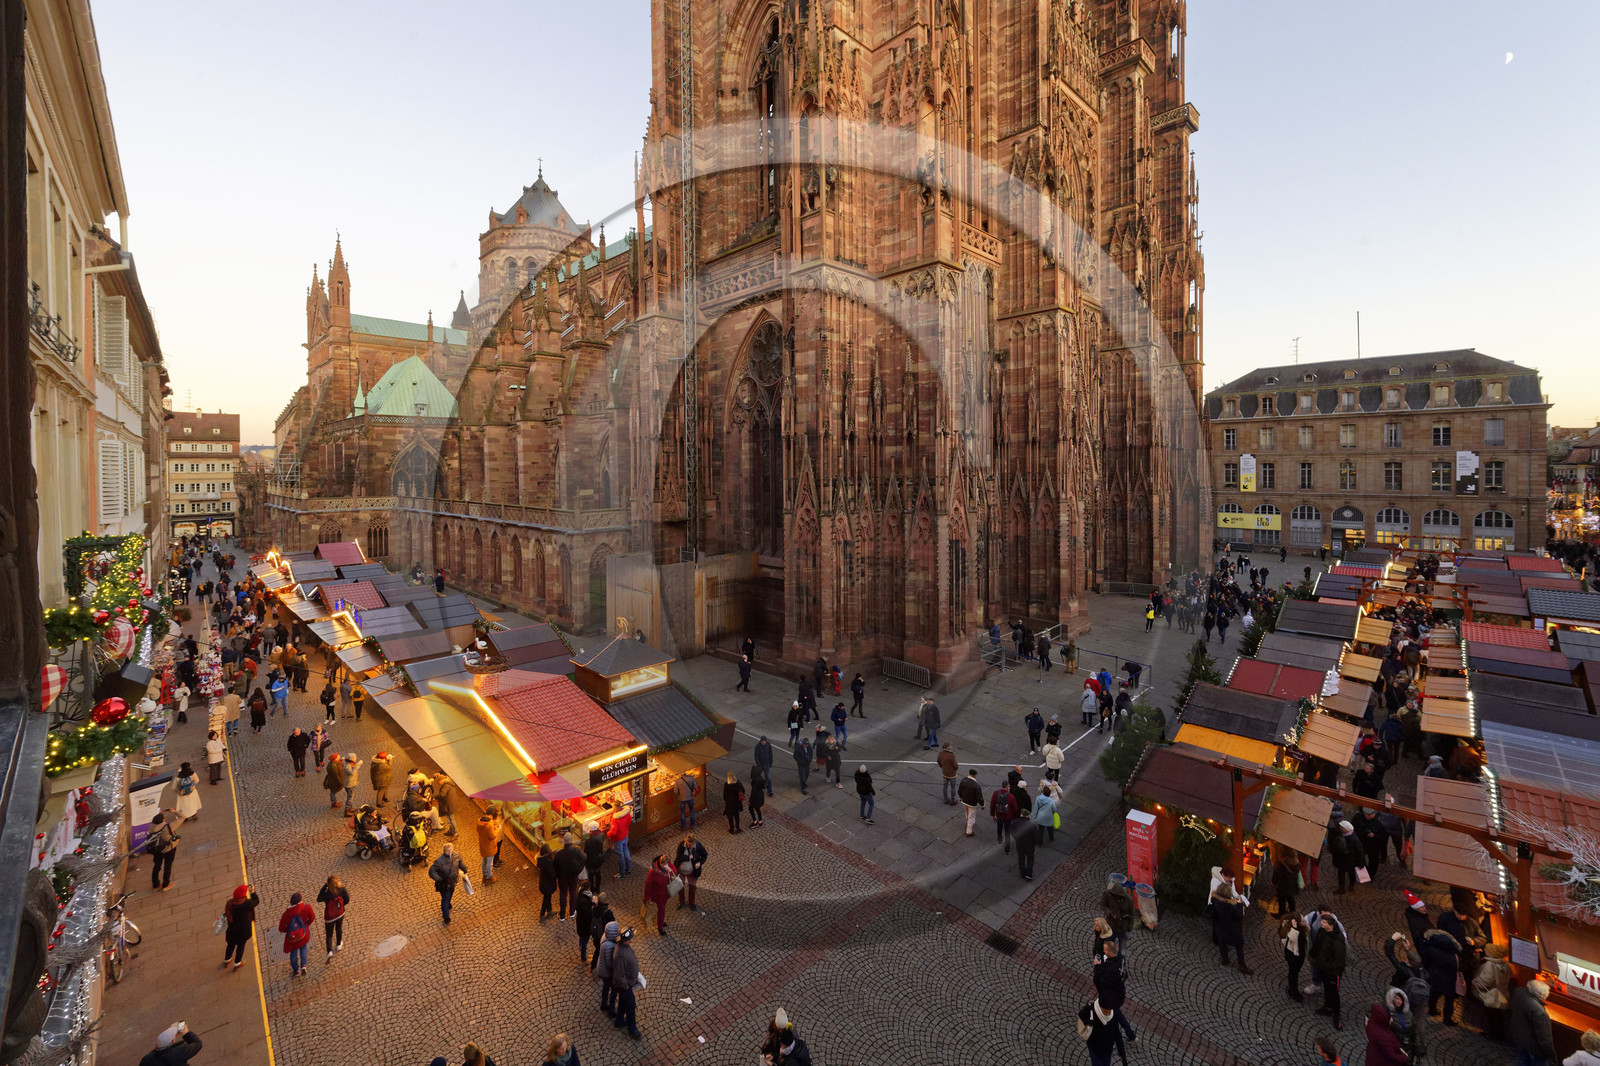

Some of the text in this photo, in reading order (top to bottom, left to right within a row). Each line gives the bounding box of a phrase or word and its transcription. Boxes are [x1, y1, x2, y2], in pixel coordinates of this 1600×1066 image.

[601, 756, 637, 774] VIN CHAUD
[602, 764, 637, 781] GLÜHWEIN
